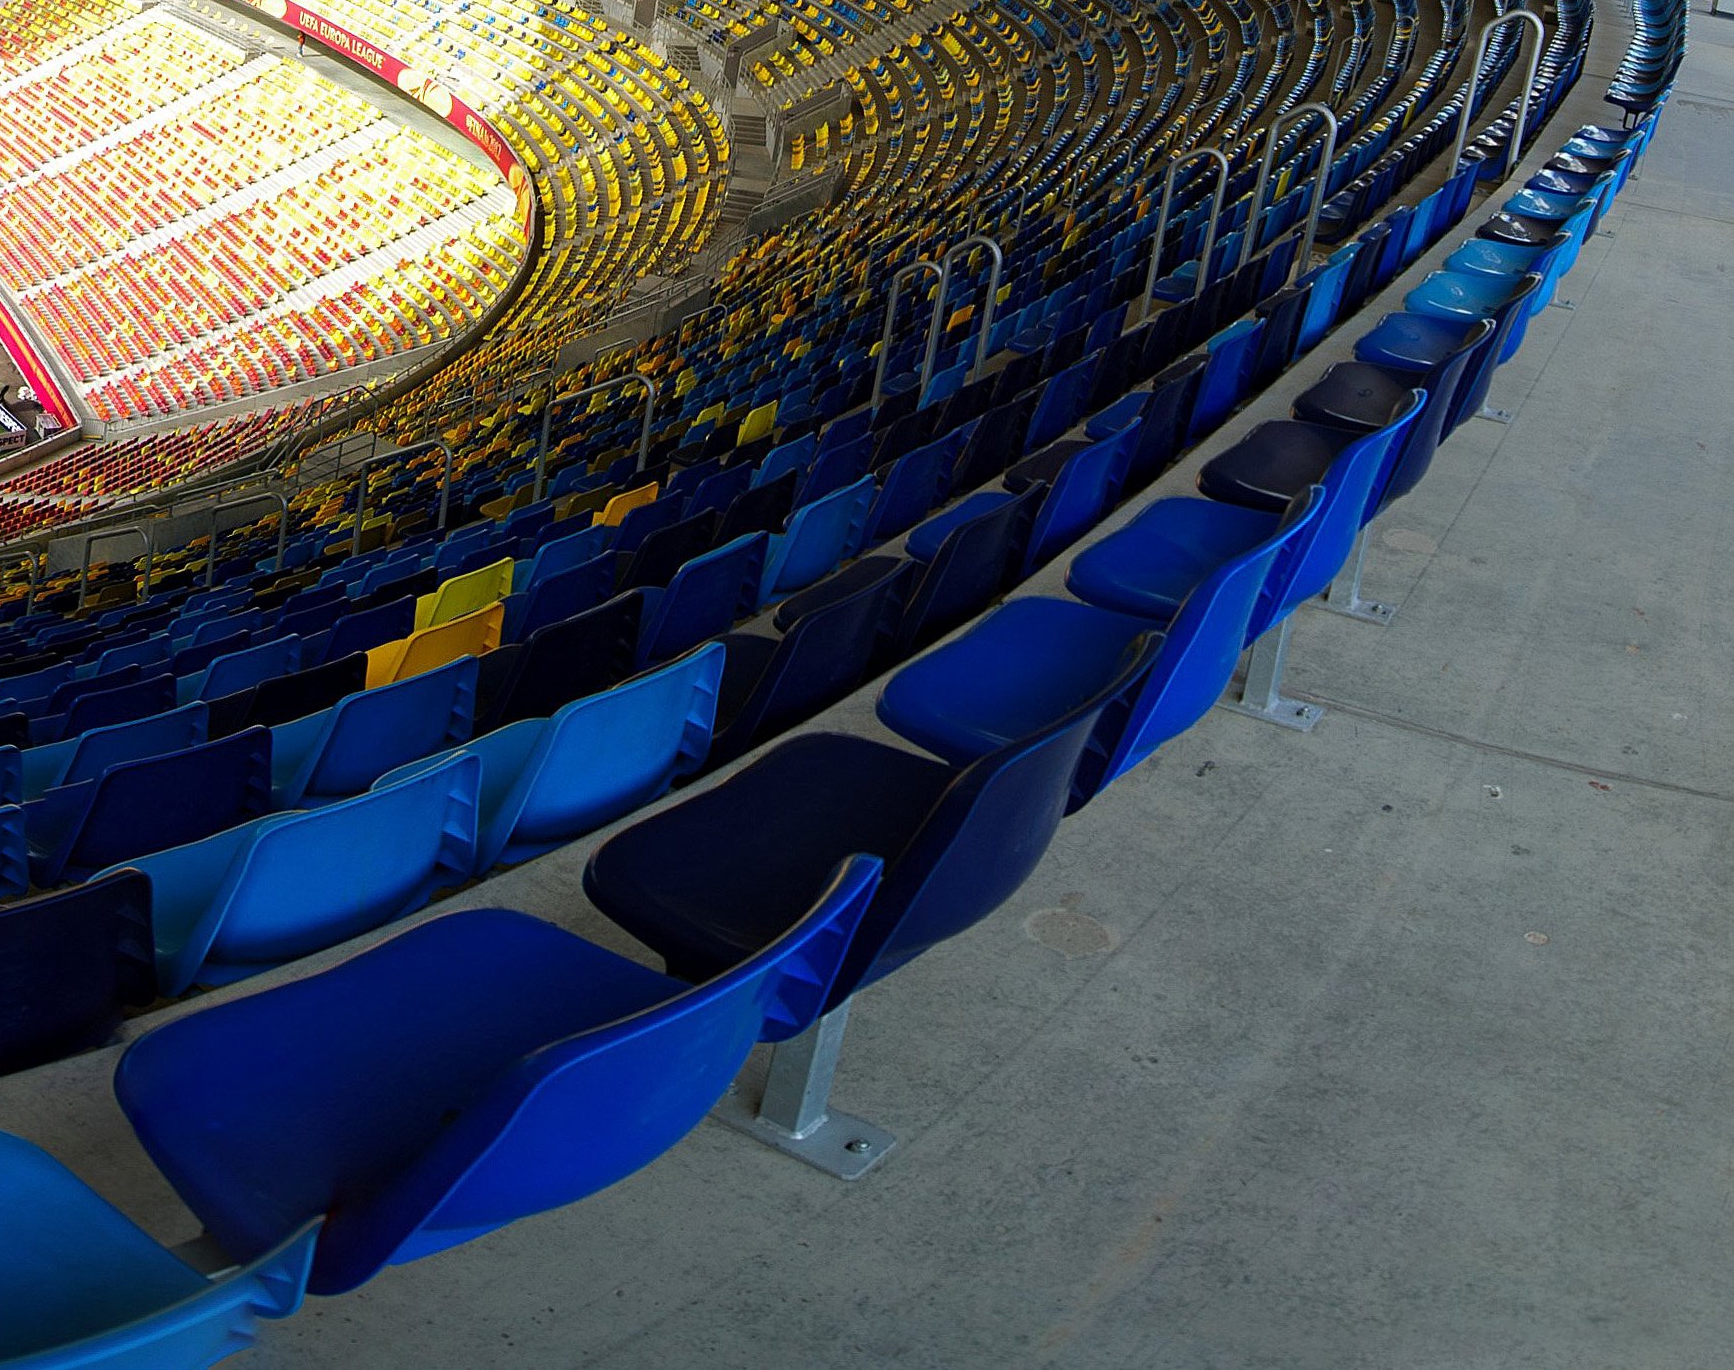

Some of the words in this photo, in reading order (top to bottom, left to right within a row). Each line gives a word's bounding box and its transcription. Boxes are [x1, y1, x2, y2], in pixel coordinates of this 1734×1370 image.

[300, 11, 318, 32] UEFA
[320, 21, 350, 51] EUROPA
[352, 39, 382, 69] LEAGUE
